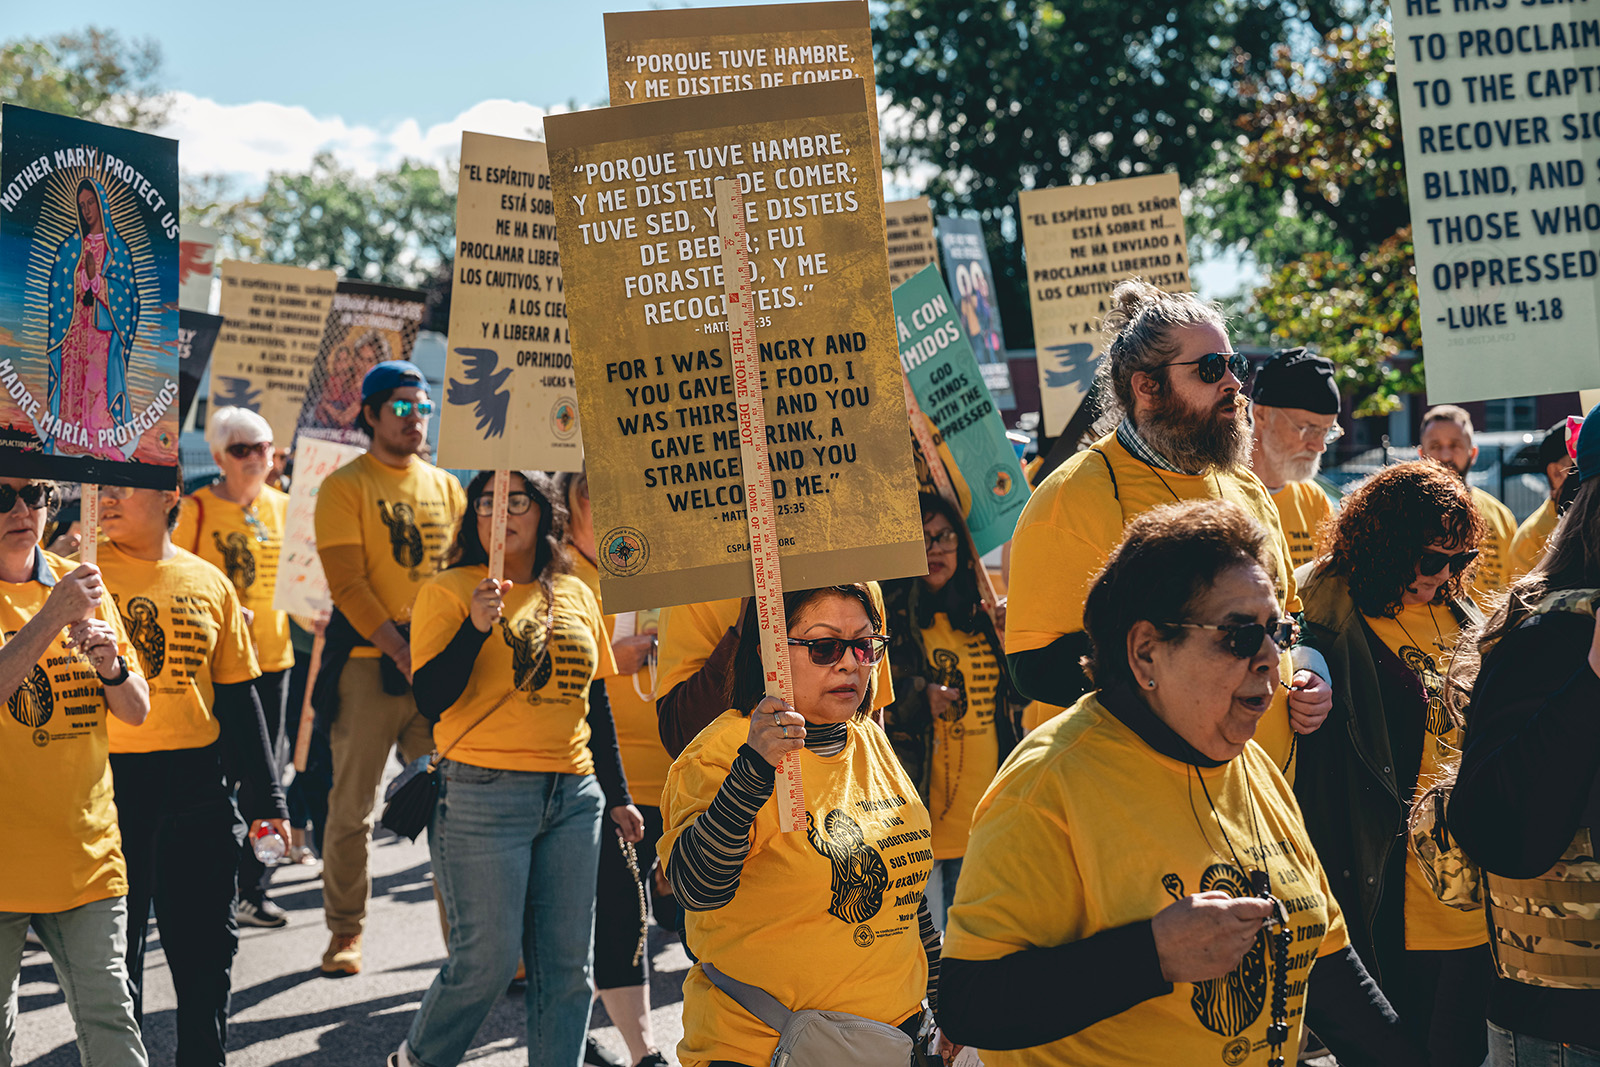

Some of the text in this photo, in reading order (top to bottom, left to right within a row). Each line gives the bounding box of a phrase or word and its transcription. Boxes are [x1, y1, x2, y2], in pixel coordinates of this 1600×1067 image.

[1404, 0, 1440, 18] HE
[1408, 18, 1600, 62] TO PROCLAIM
[626, 44, 856, 75] “PORQUE TUVE HAMBRE,
[624, 80, 637, 99] Y
[645, 79, 671, 98] ME
[678, 74, 754, 96] DISTEIS
[760, 72, 784, 89] DE
[1413, 79, 1450, 108] TO
[1461, 73, 1515, 104] THE
[1418, 117, 1550, 154] RECOVER
[573, 133, 852, 187] “PORQUE TUVE HAMBRE,
[0, 148, 180, 241] MOTHER MARY, PROTECT US
[486, 166, 535, 189] ESPÍRITU
[572, 161, 860, 216] Y ME DISTEI DE COMER;
[1422, 166, 1518, 201] BLIND,
[1527, 159, 1584, 192] AND
[501, 192, 527, 213] ESTÁ
[578, 217, 640, 246] TUVE
[645, 209, 697, 237] SED,
[702, 205, 718, 229] Y
[767, 191, 860, 221] DISTEIS
[1052, 205, 1108, 224] ESPÍRITU
[1111, 202, 1134, 217] DEL
[1138, 195, 1178, 213] SEÑOR
[496, 219, 511, 236] ME
[514, 222, 529, 238] HA
[1072, 223, 1103, 240] ESTÁ
[1107, 217, 1146, 237] SOBRE
[1427, 204, 1600, 246] THOSE WHO
[460, 241, 525, 266] PROCLAMAR
[639, 244, 670, 268] DE
[767, 226, 806, 251] FUI
[1070, 234, 1182, 259] ME HA ENVIADO A
[460, 268, 554, 293] LOS CAUTIVOS, Y
[624, 252, 829, 298] FORASTEO, Y ME
[1033, 252, 1184, 284] PROCLAMAR LIBERTAD A
[1432, 250, 1596, 292] OPPRESSED
[1037, 270, 1186, 301] LOS VISTA
[509, 299, 516, 315] A
[520, 300, 542, 317] LOS
[911, 294, 948, 331] CON
[1436, 297, 1563, 330] -LUKE 4:18
[482, 323, 562, 344] Y A LIBERAR A
[704, 321, 730, 335] MATE
[1069, 322, 1077, 337] Y
[606, 330, 868, 383] FOR I WAS NGRY AND
[929, 358, 952, 381] GOD
[625, 361, 855, 408] YOU GAVE FOOD, I
[731, 328, 754, 447] THE HOME DEPOT
[928, 369, 968, 403] STANDS
[0, 358, 179, 449] MADRE MARÍA, PROTÉGENOS
[617, 385, 871, 437] WAS THIRS AND YOU
[928, 381, 982, 423] WITH THE
[932, 396, 992, 442] OPPRESSED
[651, 416, 844, 460] GAVE ME RINK, A
[644, 456, 742, 489] STRANGE
[811, 441, 858, 466] YOU
[666, 471, 842, 514] WELCOD ME.”
[777, 502, 806, 517] 25:35
[747, 484, 770, 631] HOME OF THE FINEST PAINTS
[54, 671, 71, 684] sus
[876, 829, 921, 852] poderosos
[889, 847, 933, 870] sus tronos
